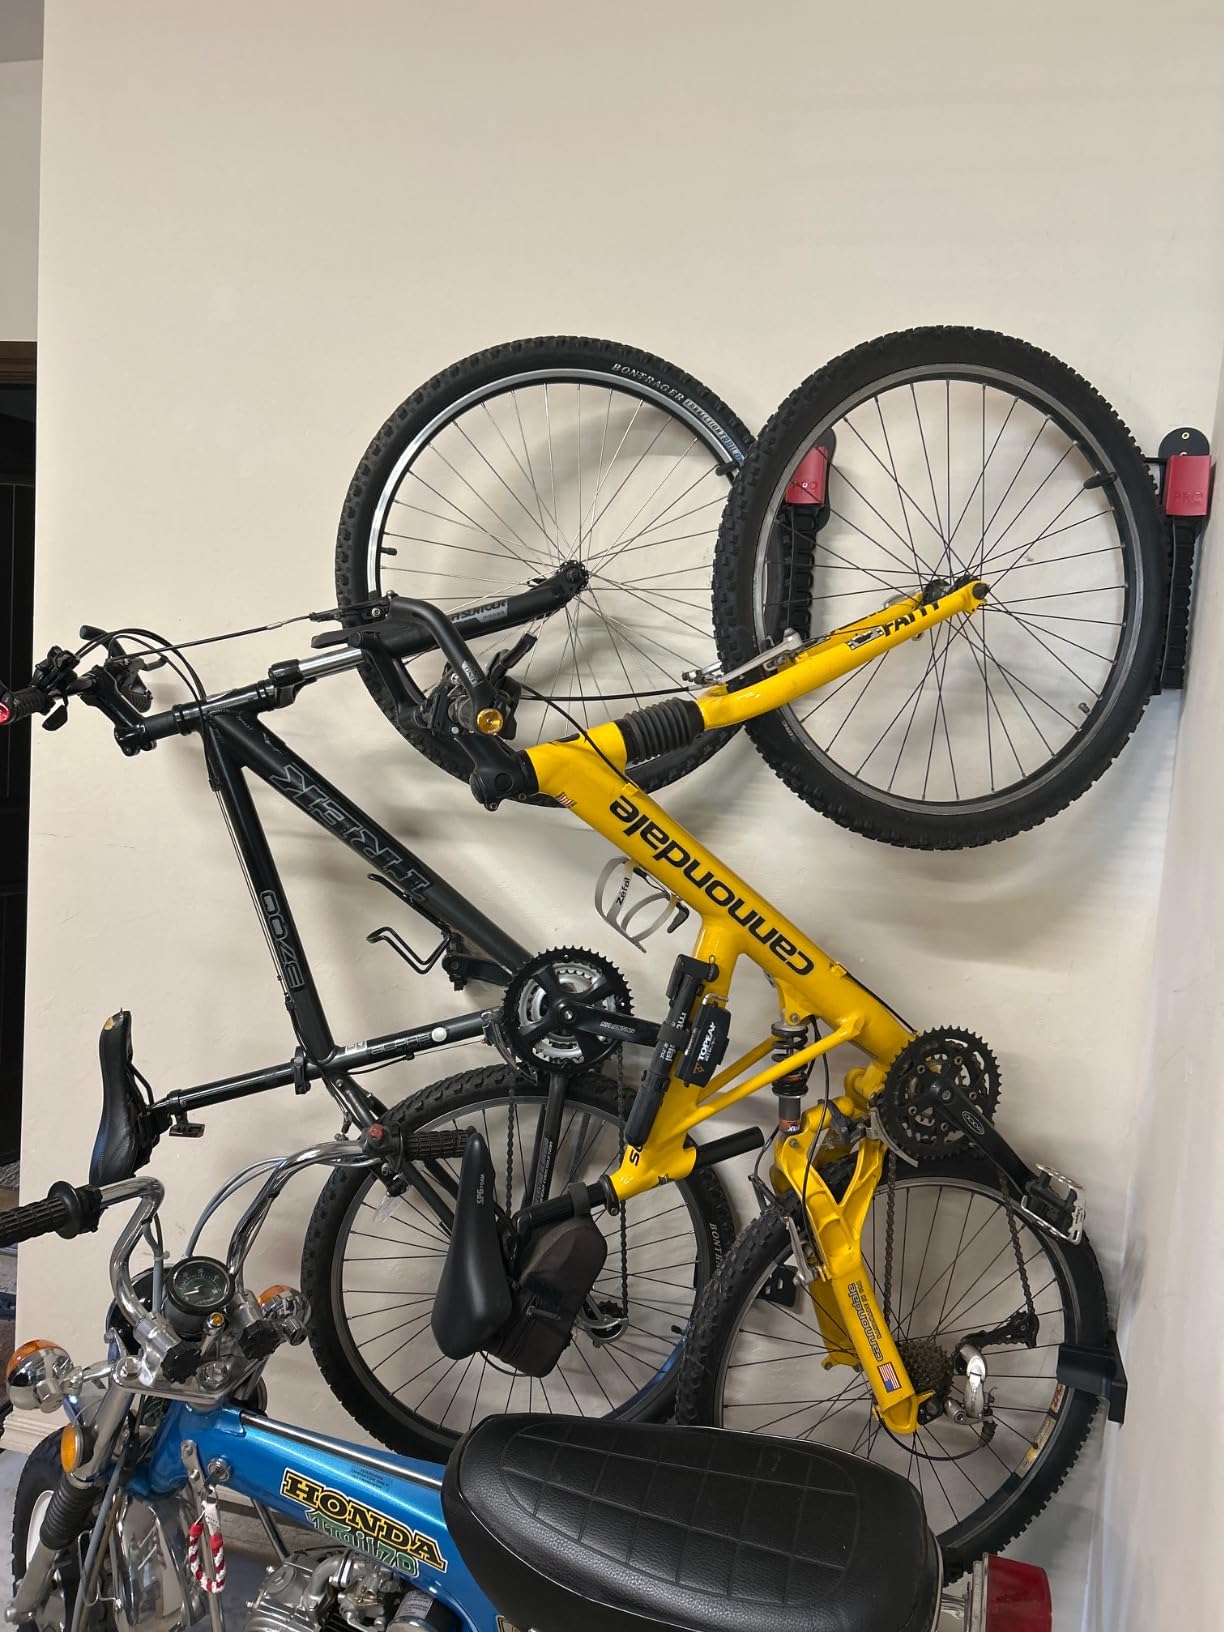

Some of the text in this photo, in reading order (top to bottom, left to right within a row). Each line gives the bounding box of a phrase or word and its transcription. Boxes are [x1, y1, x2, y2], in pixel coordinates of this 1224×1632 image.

[611, 363, 685, 401] BONTRAGER
[269, 764, 431, 901] TREK
[609, 795, 815, 976] cannondale
[261, 890, 305, 989] 3700
[697, 1021, 716, 1061] TOPEAK
[847, 1282, 883, 1362] cannondale
[281, 1469, 447, 1572] HONDA
